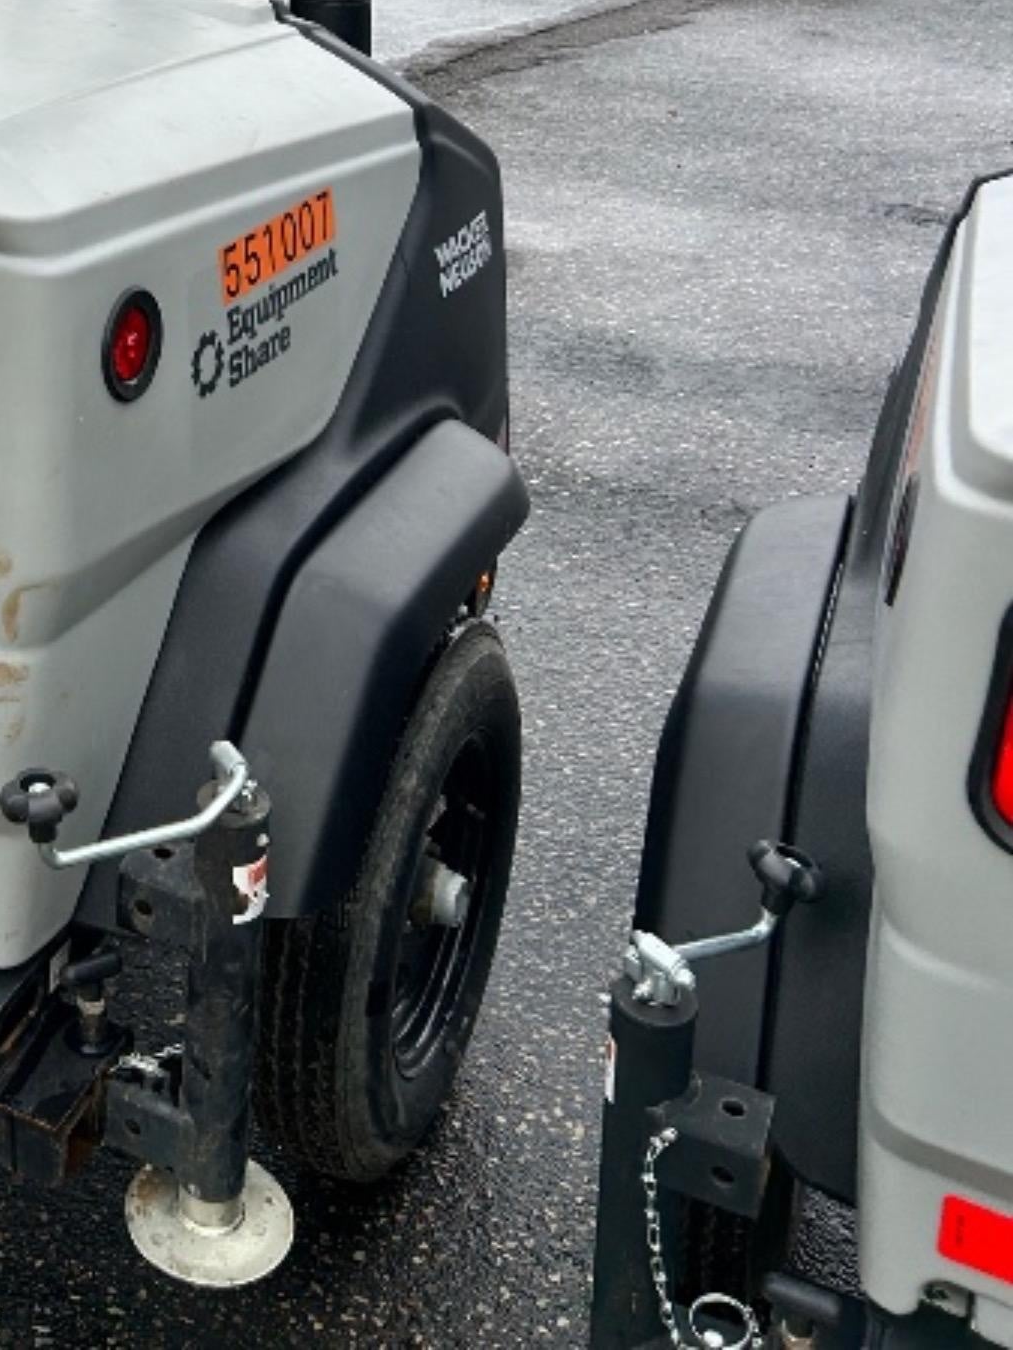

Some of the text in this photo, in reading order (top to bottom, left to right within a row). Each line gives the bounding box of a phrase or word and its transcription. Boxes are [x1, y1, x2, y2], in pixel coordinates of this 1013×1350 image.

[222, 191, 330, 298] 551007
[226, 247, 339, 345] Equipment
[228, 325, 292, 388] Share
